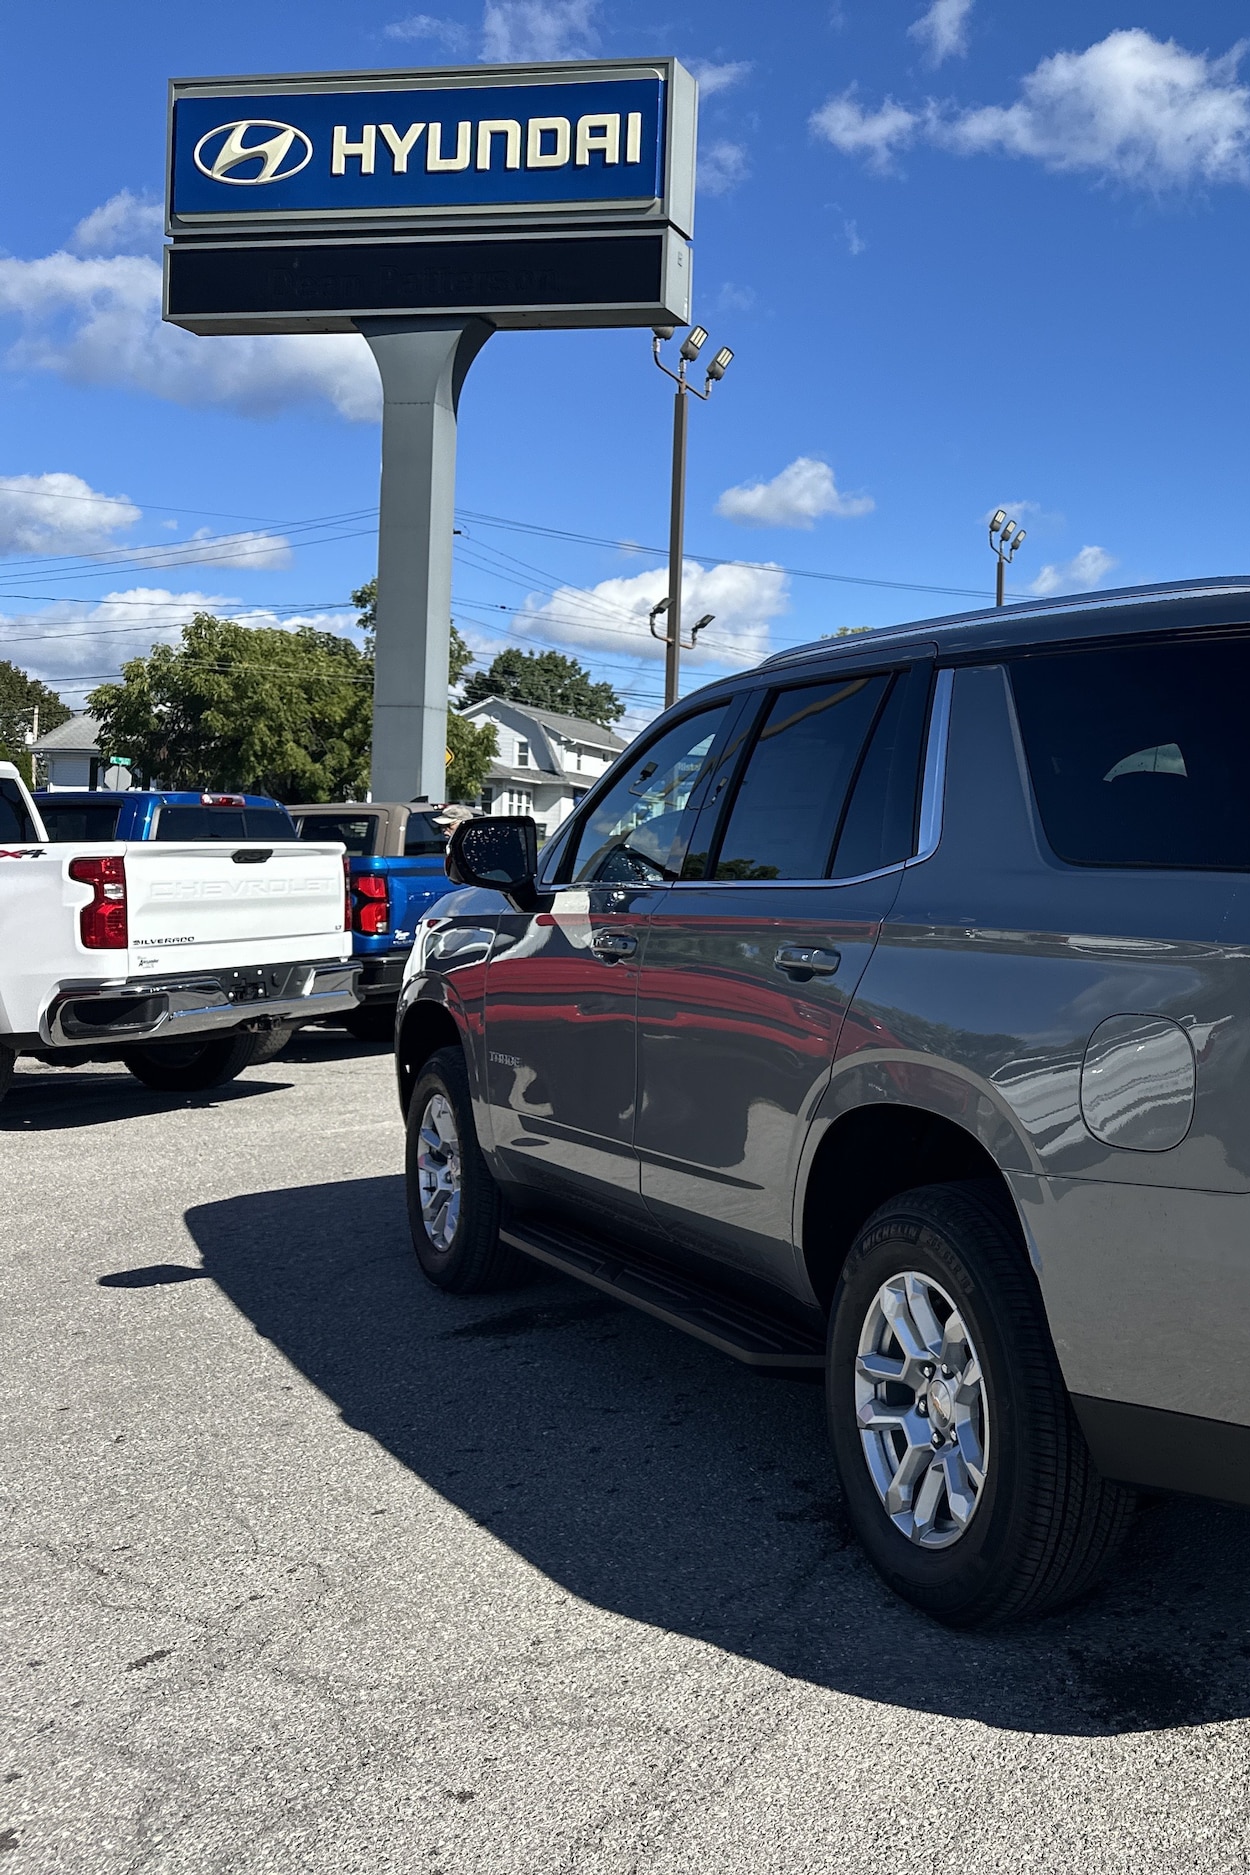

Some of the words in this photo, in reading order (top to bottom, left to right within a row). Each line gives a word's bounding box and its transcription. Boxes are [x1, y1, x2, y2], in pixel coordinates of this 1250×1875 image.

[331, 112, 642, 175] HYUNDAI
[150, 877, 336, 898] CHEVROLET
[132, 936, 195, 946] SILVERADO
[862, 1223, 918, 1253] MICHELIN
